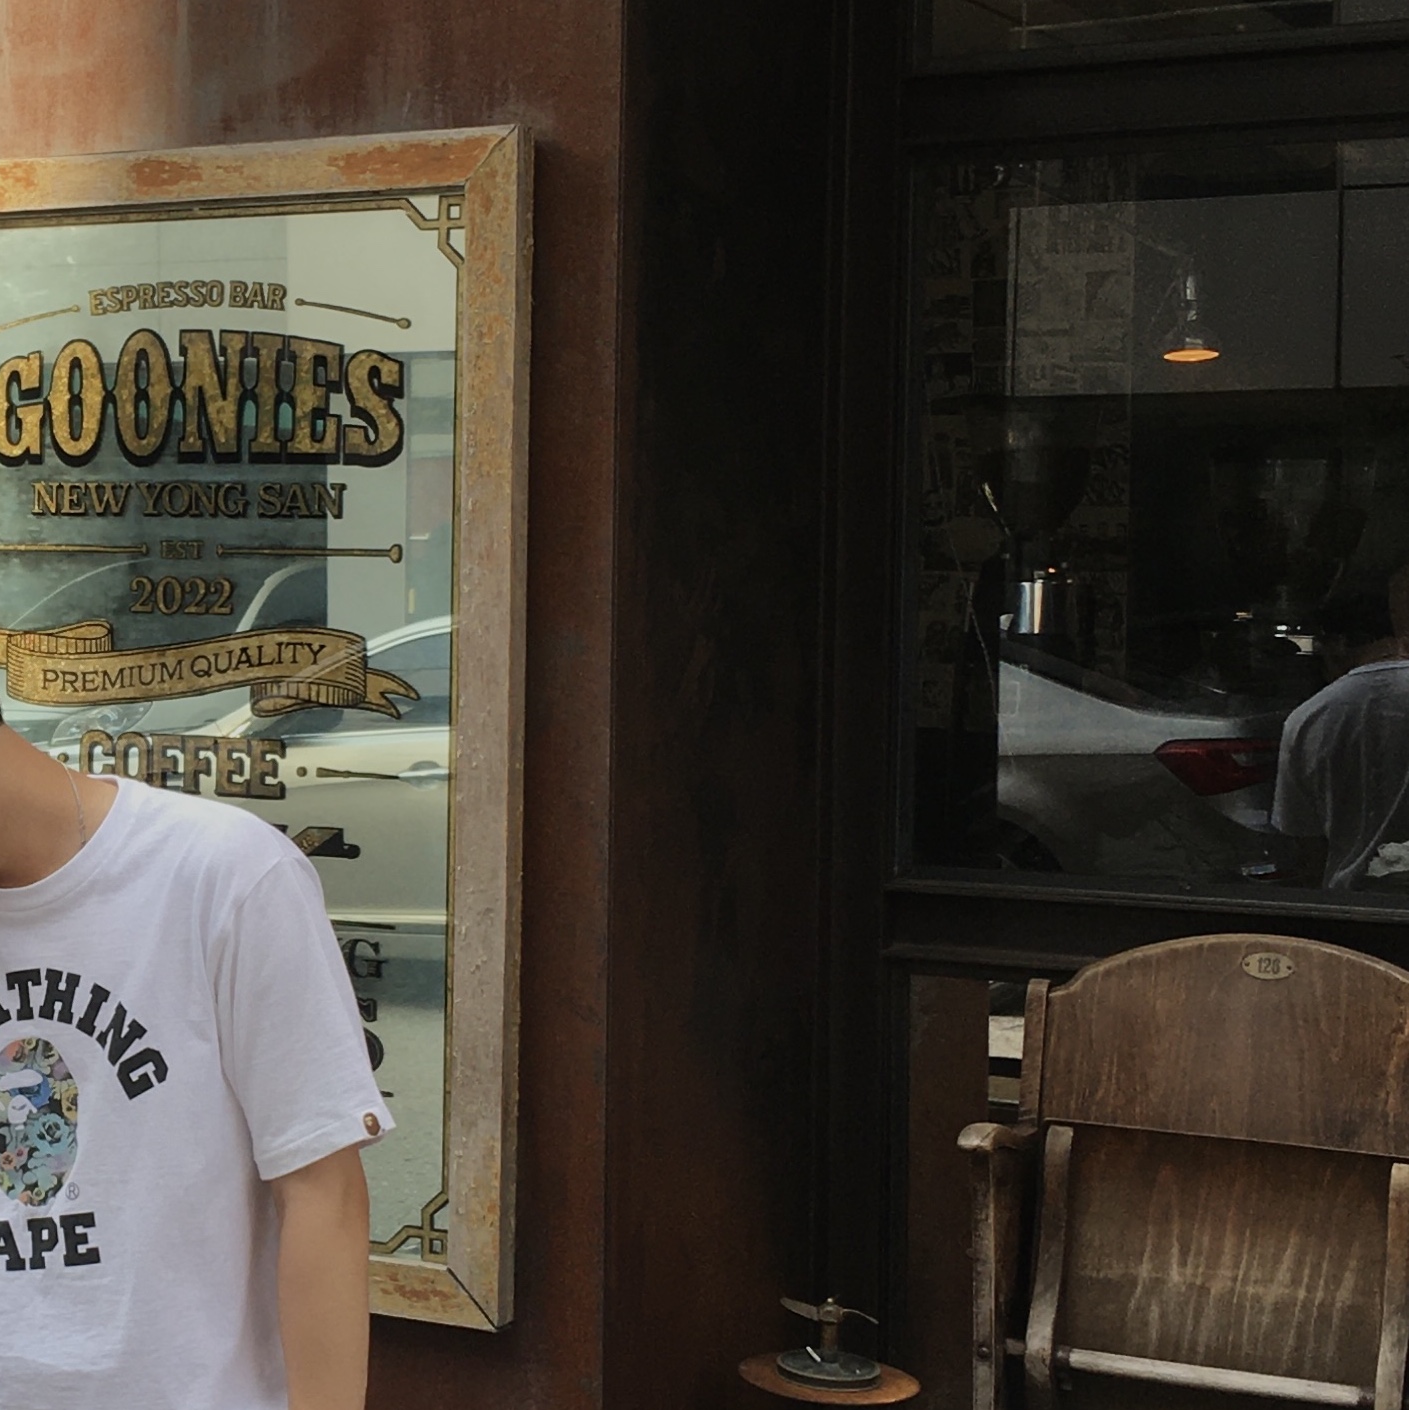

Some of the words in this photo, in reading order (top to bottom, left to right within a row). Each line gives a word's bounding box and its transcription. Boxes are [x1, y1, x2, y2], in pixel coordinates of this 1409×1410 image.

[88, 280, 222, 316] ESPRESSO
[228, 280, 287, 312] BAR
[30, 481, 131, 517] NEW
[136, 481, 249, 519] YONG
[257, 481, 347, 520] SAN
[159, 539, 205, 560] EST
[128, 577, 235, 616] 2022
[40, 659, 185, 694] PREMIUM
[190, 639, 328, 679] QUALITY
[79, 729, 287, 799] COFFEE
